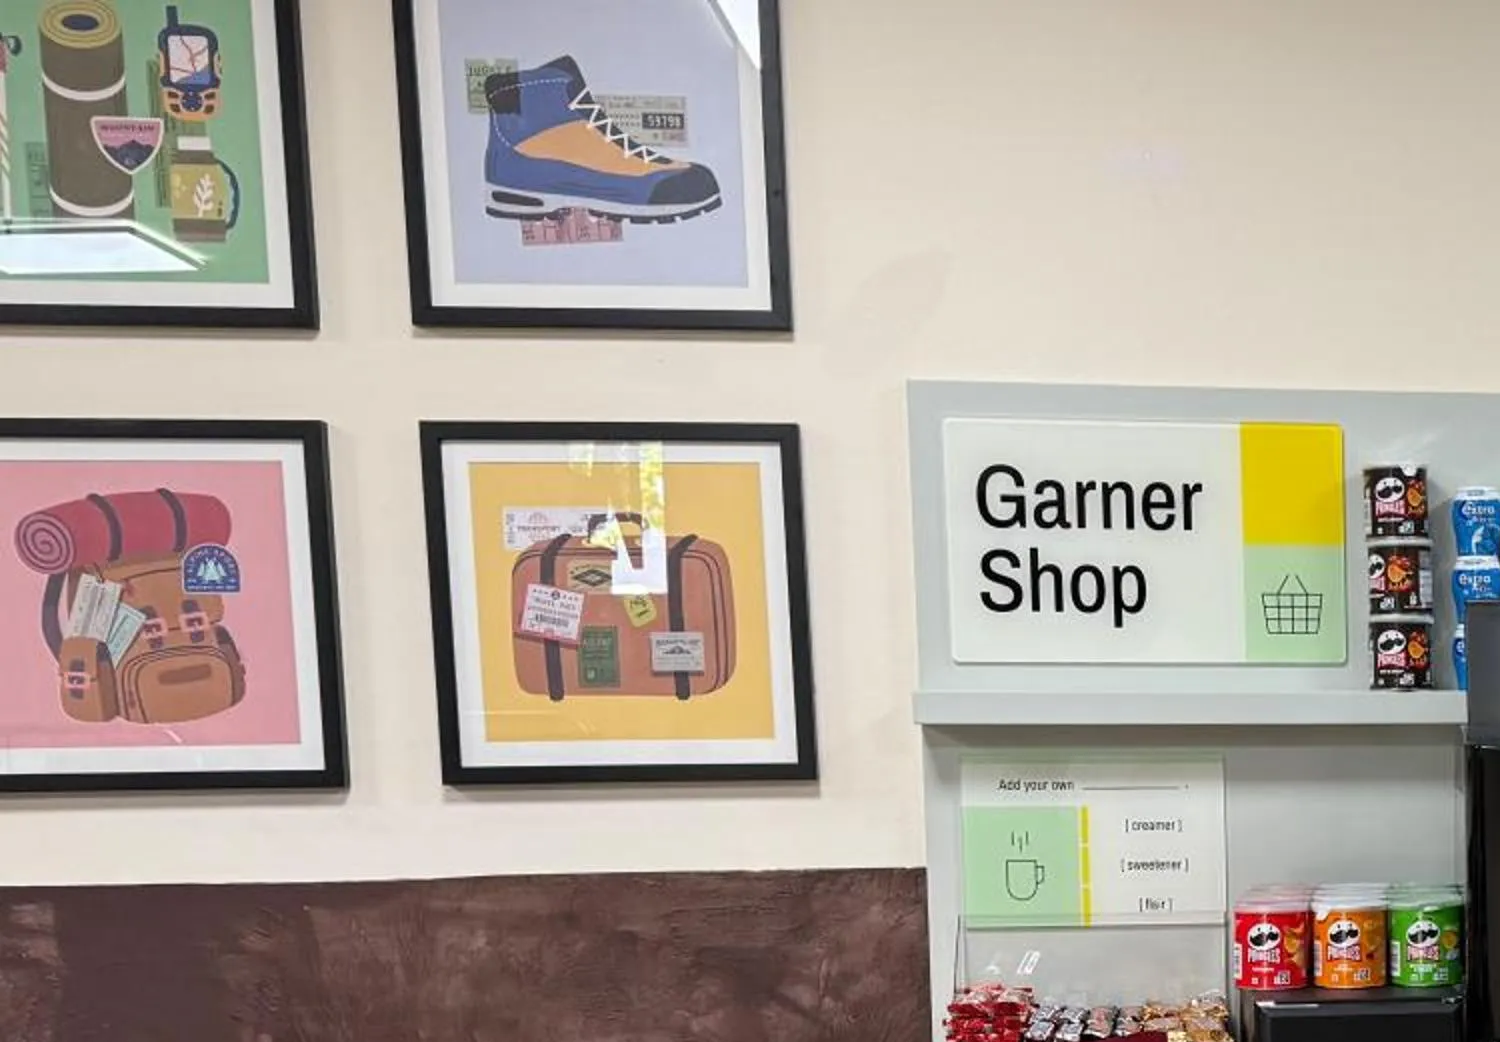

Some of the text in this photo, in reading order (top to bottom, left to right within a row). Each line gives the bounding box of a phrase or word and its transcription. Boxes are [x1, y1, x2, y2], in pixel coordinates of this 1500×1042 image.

[976, 463, 1203, 531] Garner
[979, 547, 1147, 628] Shop
[995, 778, 1075, 793] Add your own
